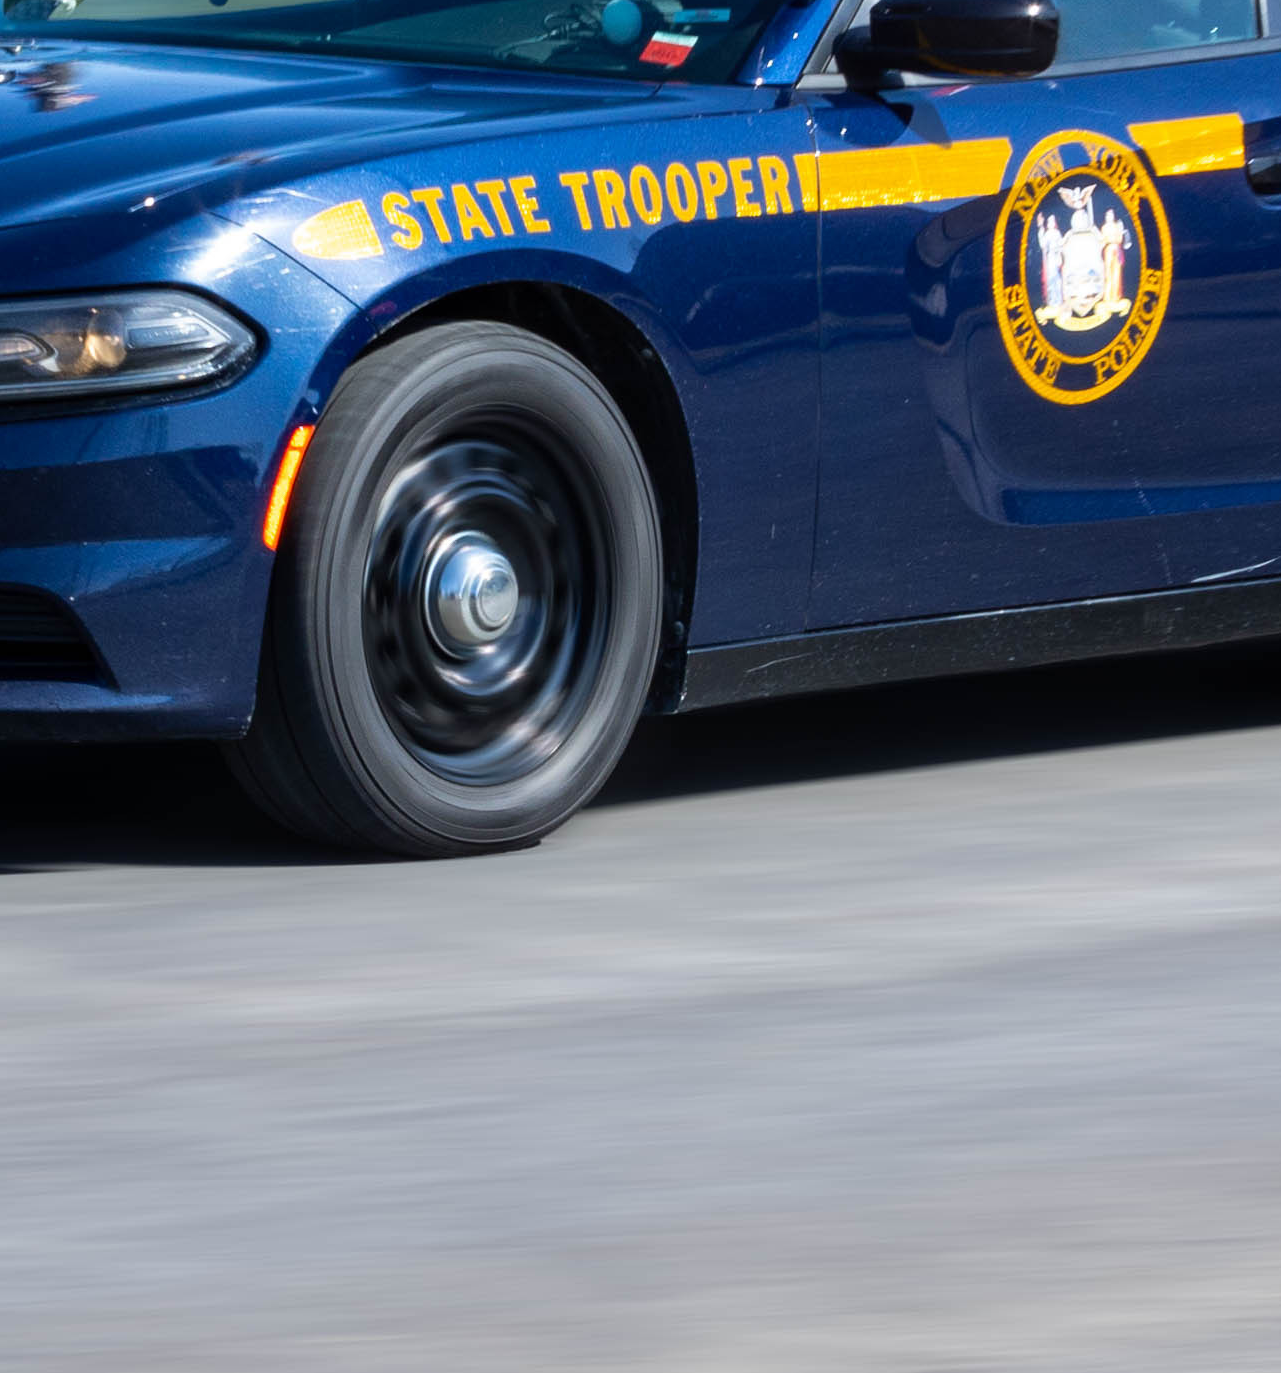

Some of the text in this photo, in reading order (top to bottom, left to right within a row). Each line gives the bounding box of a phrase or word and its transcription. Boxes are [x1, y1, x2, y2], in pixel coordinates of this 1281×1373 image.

[381, 155, 795, 251] STATE TROOPER
[1011, 141, 1144, 222] NEW YORK
[1003, 268, 1164, 385] STATE POLICE
